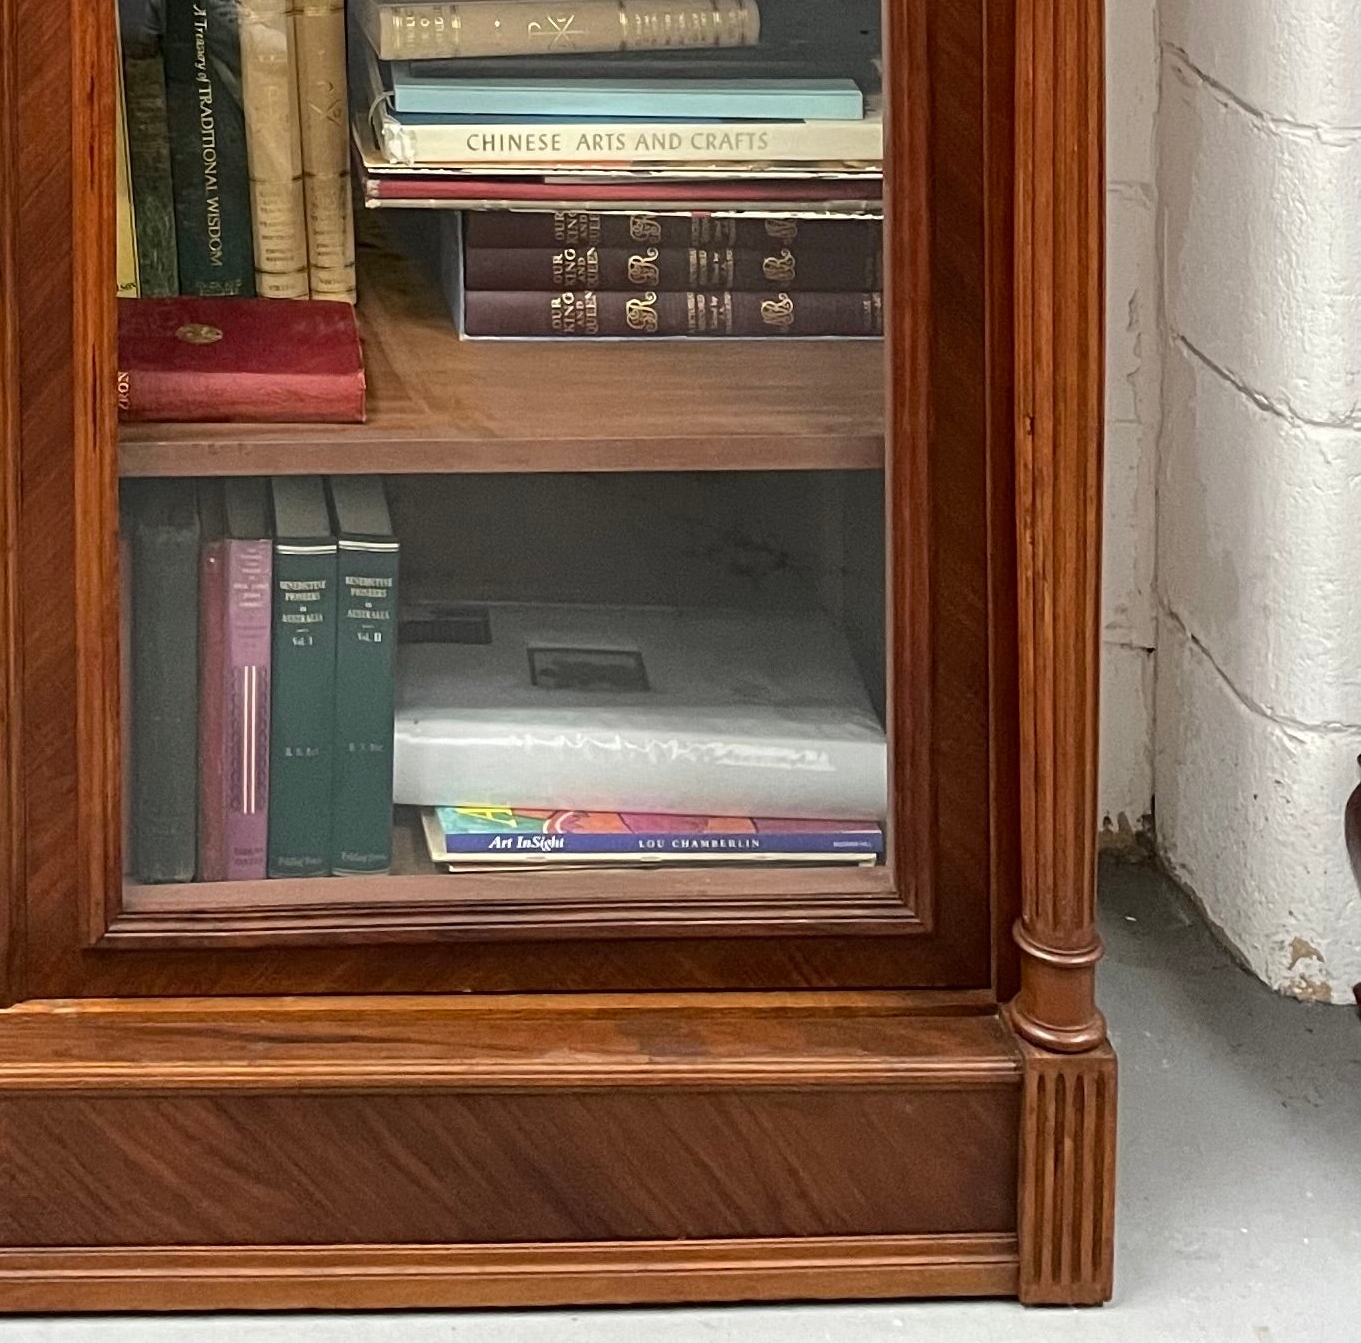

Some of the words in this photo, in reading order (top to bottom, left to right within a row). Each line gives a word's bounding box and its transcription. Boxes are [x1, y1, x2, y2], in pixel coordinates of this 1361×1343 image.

[194, 18, 208, 71] Treasury
[195, 71, 211, 84] of
[198, 80, 219, 191] TRADITIONAL
[466, 132, 562, 152] CHINESE
[575, 131, 627, 152] ARTS
[633, 131, 683, 151] AND
[689, 130, 769, 151] CRAFTS
[205, 195, 223, 267] WISDOM
[579, 212, 589, 240] AND
[552, 252, 564, 284] OUR
[563, 247, 577, 287] KING
[576, 256, 587, 282] AND
[586, 246, 599, 288] QUEEN
[550, 296, 563, 330] OUR
[561, 290, 576, 334] KING
[574, 299, 586, 328] AND
[584, 290, 599, 335] QUEEN
[284, 591, 321, 602] PIONEERS
[350, 587, 388, 598] PIONEERS
[281, 613, 324, 624] AUSTRALIA
[346, 609, 391, 620] AUSTRALIA
[488, 835, 513, 849] Art
[515, 834, 565, 852] InSight
[638, 838, 665, 849] LOU
[671, 837, 760, 849] CHAMBERLIN
